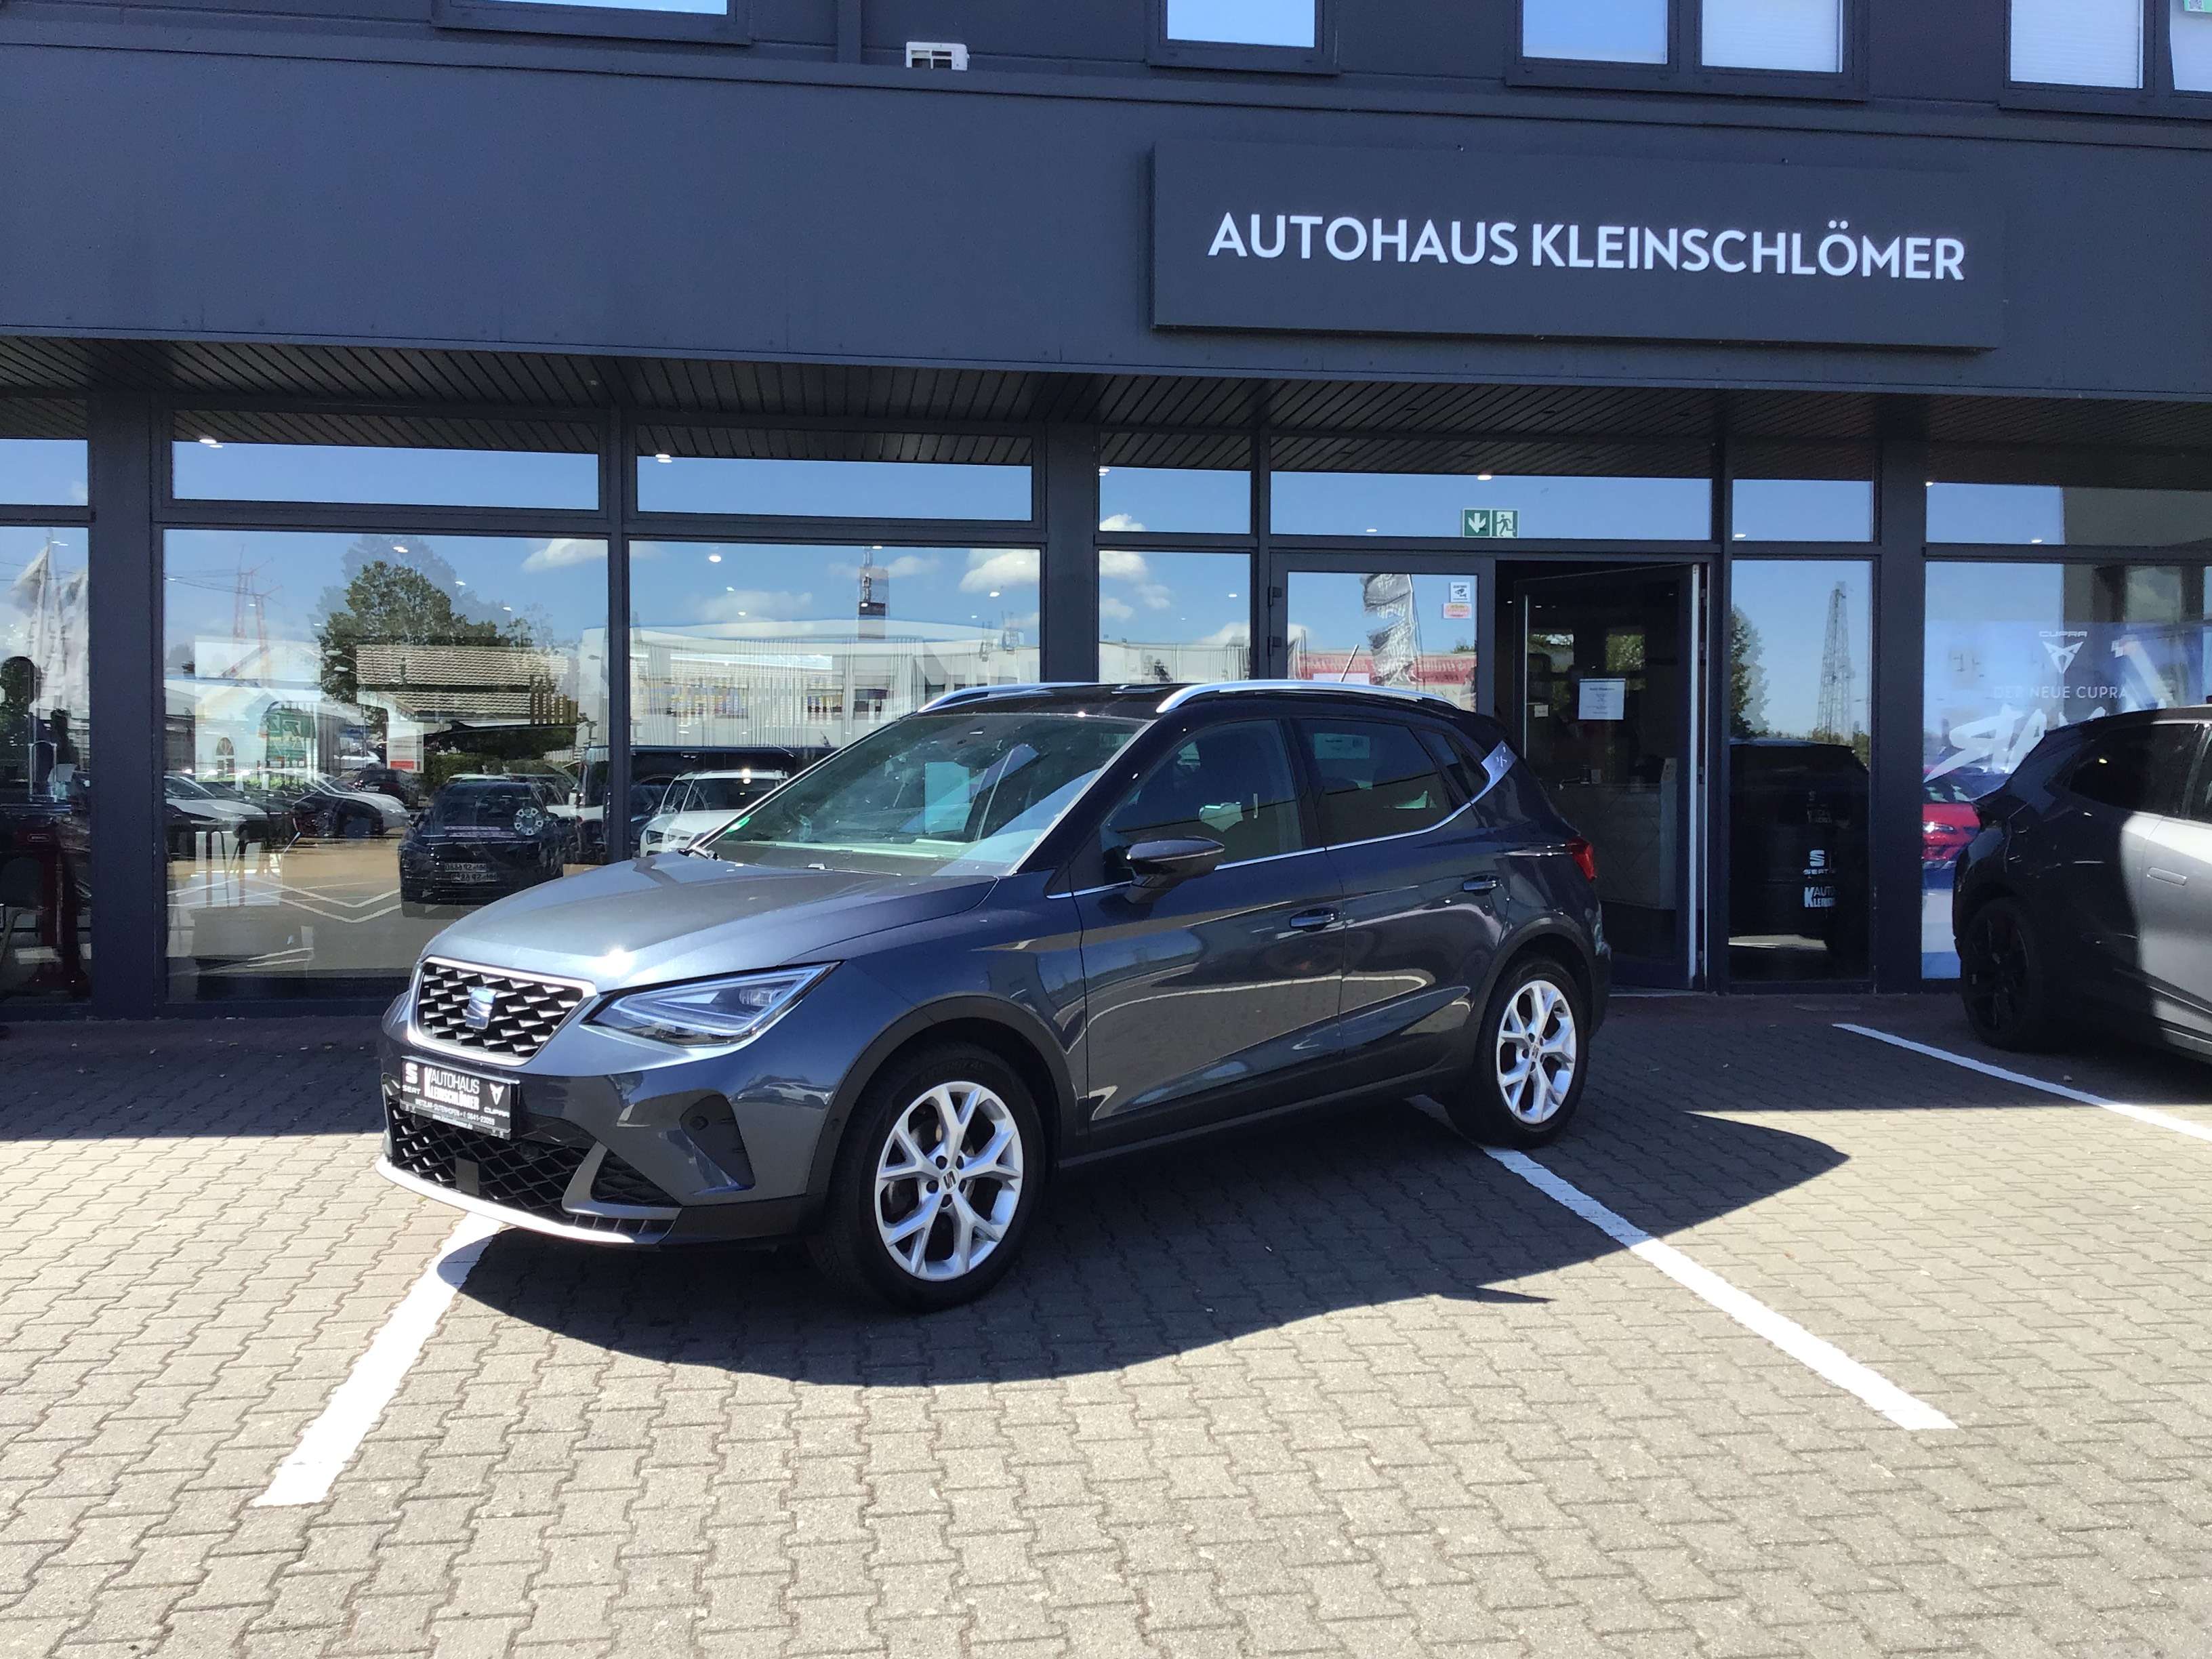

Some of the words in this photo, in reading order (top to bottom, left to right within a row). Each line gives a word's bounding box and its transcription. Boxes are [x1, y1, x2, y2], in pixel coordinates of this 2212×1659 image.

[1208, 212, 1518, 265] AUTOHAUS
[1532, 221, 1965, 281] KLEINSCHLÖMER
[2030, 686, 2070, 699] NEUE
[2076, 686, 2127, 699] CUPRA
[403, 1084, 421, 1095] SEAT
[430, 1069, 480, 1094] AUTOHAUS
